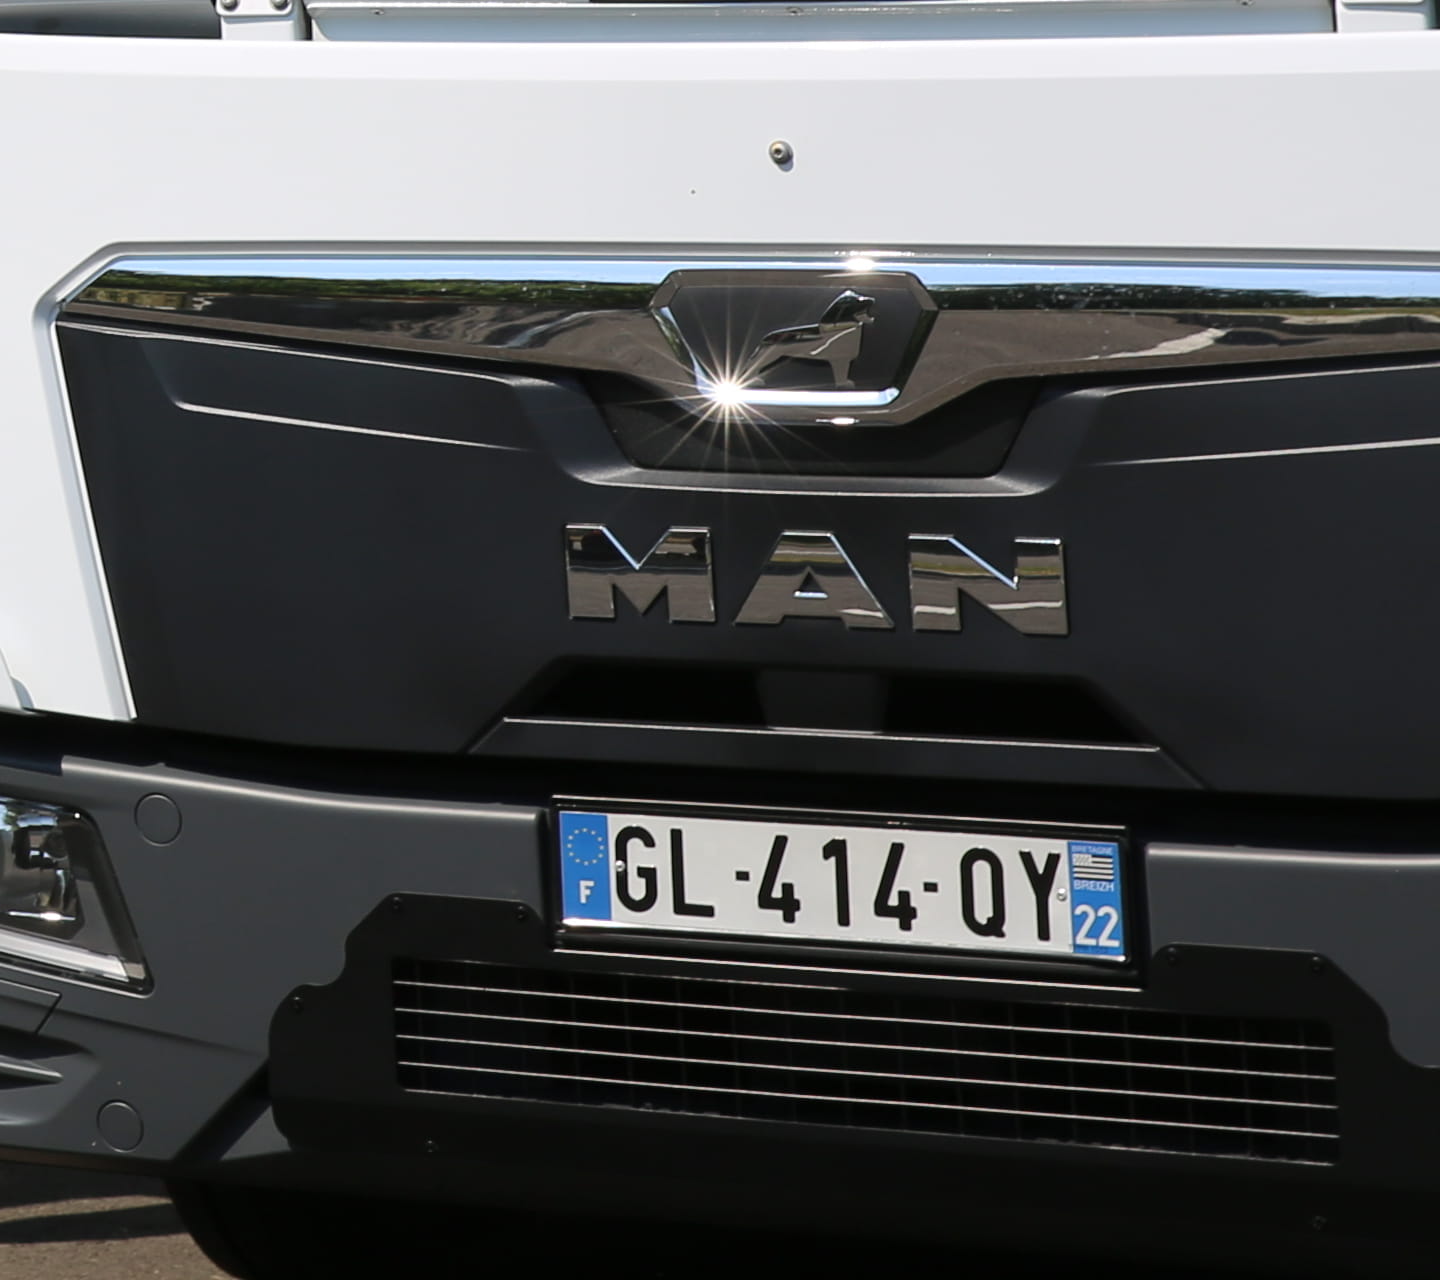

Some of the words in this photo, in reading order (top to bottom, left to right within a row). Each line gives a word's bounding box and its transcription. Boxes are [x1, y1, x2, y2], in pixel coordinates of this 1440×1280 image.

[564, 524, 1071, 636] MAN
[578, 880, 595, 905] F
[1072, 878, 1116, 893] BREIZH
[1073, 903, 1121, 948] 22
